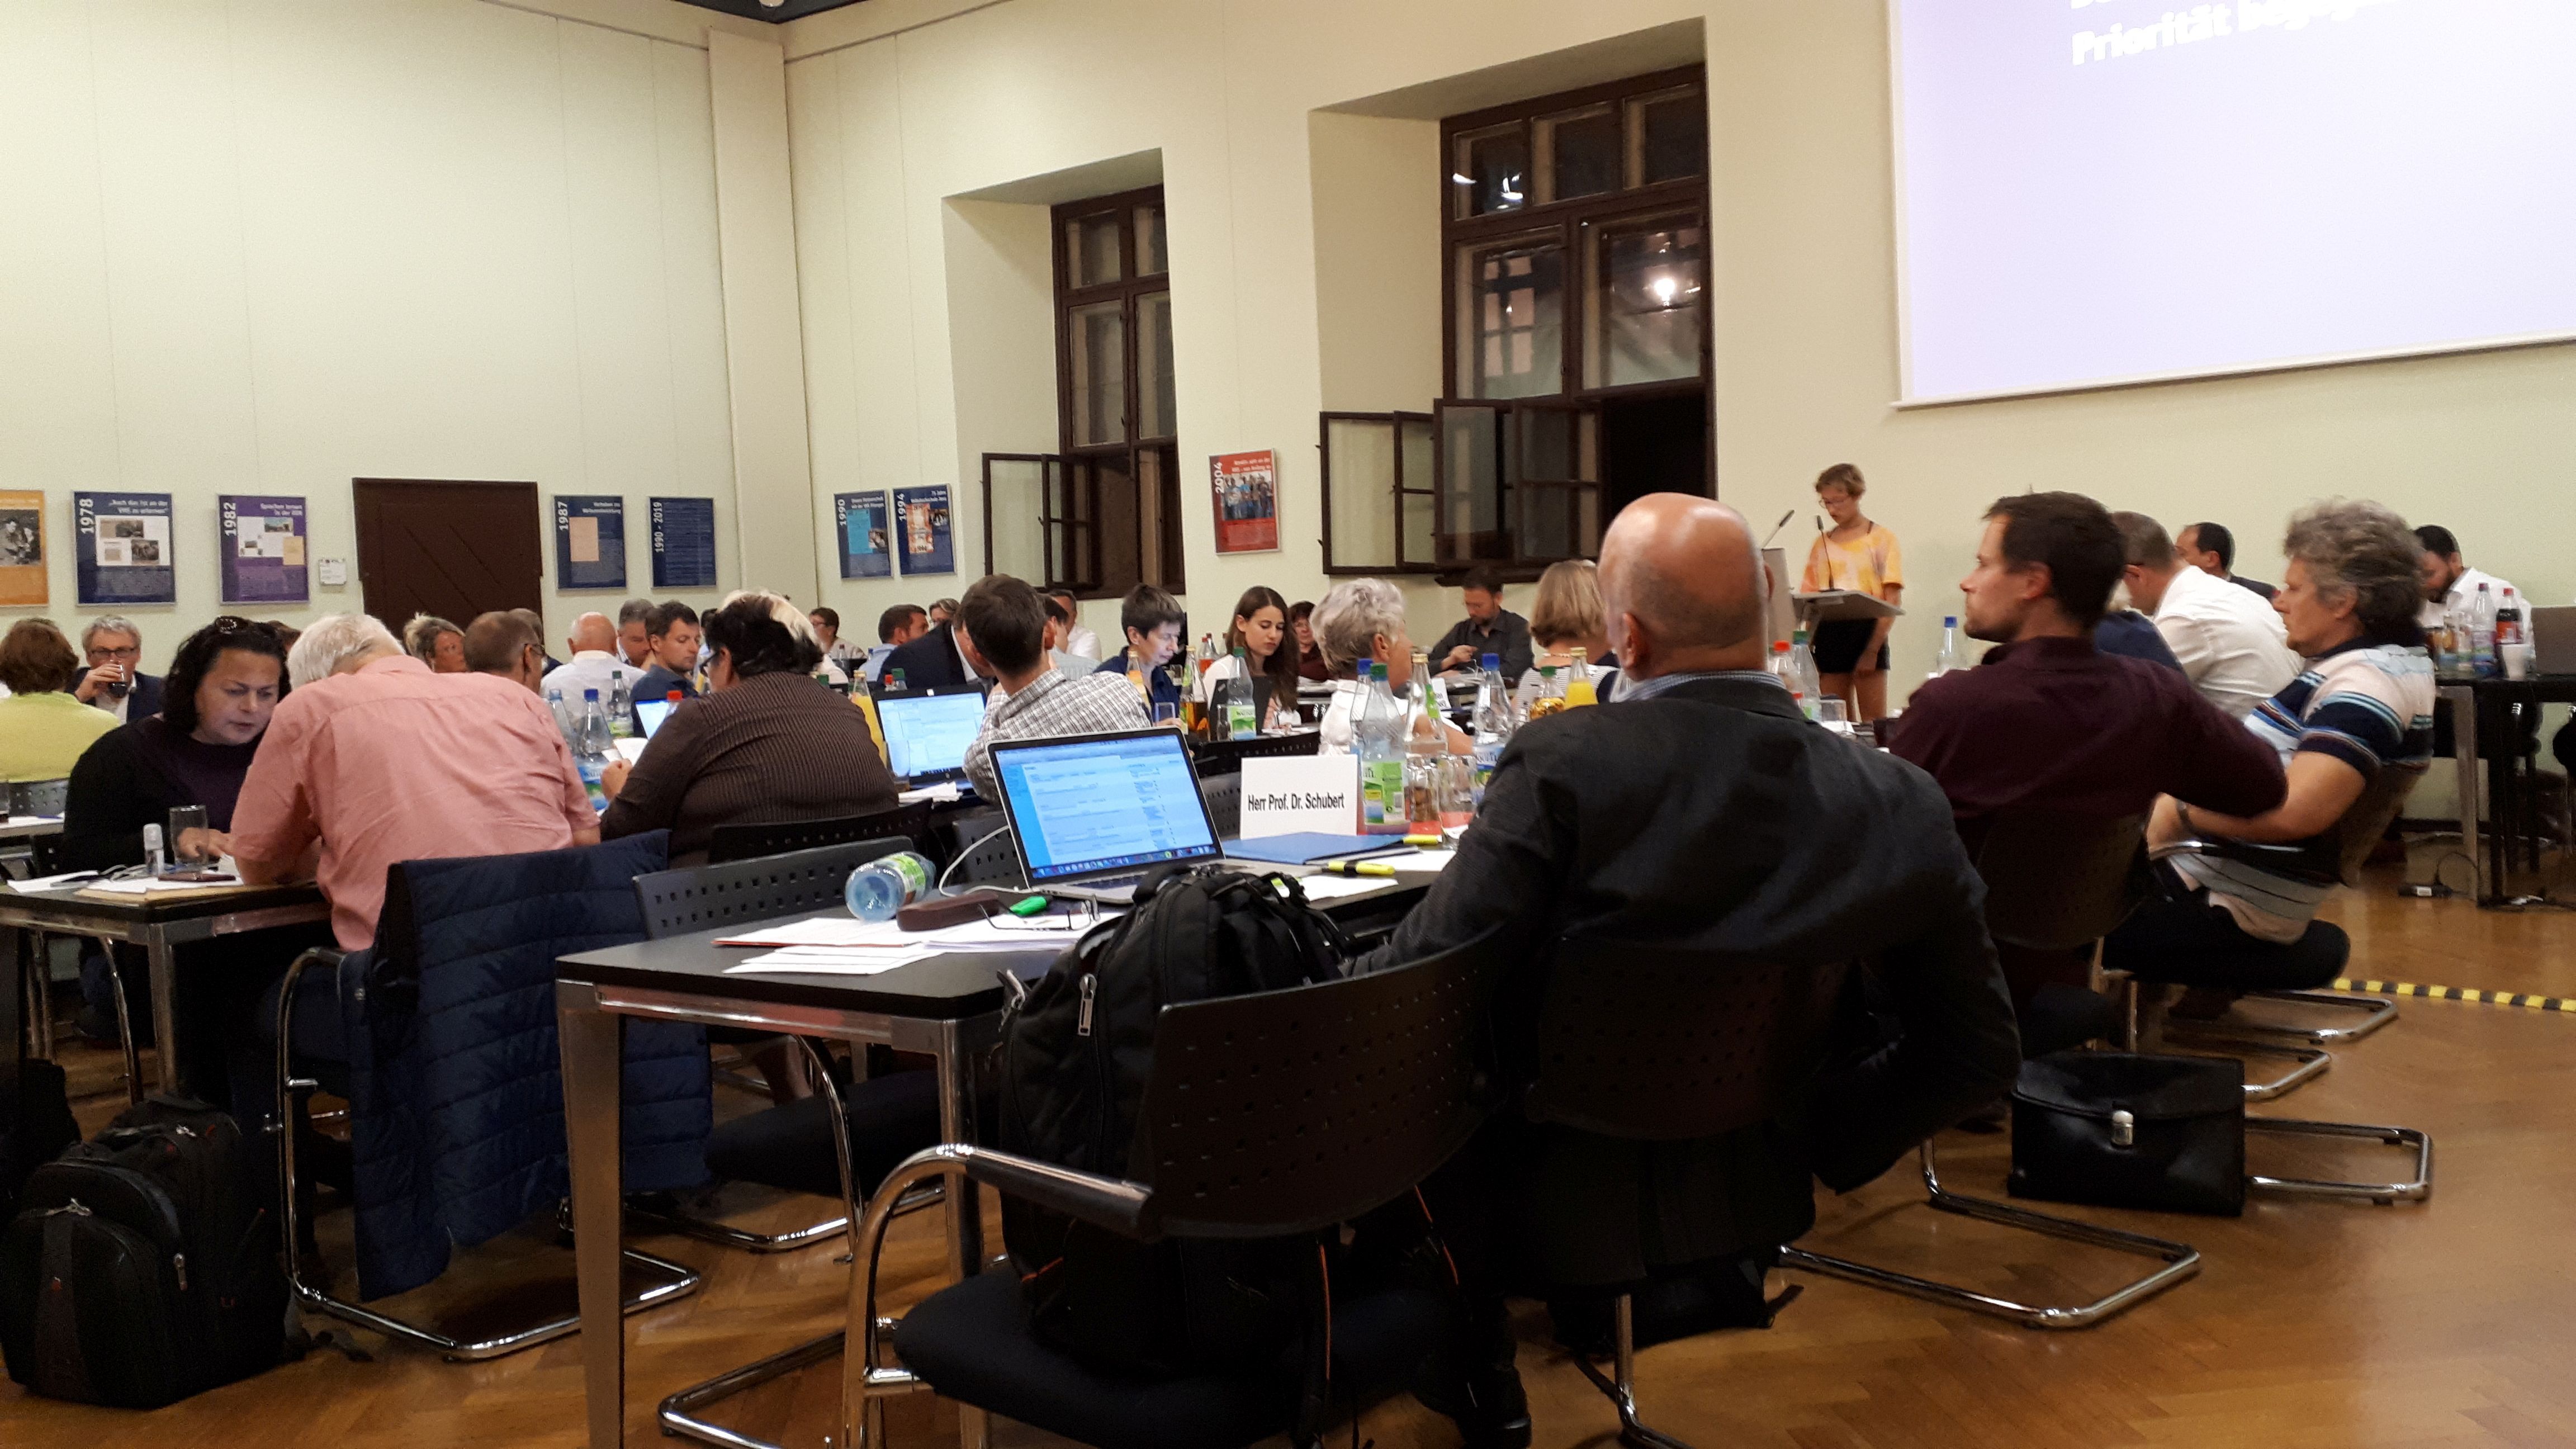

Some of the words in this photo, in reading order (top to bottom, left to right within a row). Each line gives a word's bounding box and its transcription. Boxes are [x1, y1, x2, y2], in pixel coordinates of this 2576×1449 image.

[2072, 3, 2232, 65] Priorität
[1214, 462, 1225, 494] 2004
[79, 498, 95, 534] 1978
[224, 502, 236, 537] 1982
[557, 501, 569, 531] 1987
[652, 501, 664, 523] 2019
[837, 499, 847, 527] 1990
[897, 493, 906, 522] 1994
[654, 531, 664, 553] 1990
[1248, 794, 1266, 811] Herr
[1268, 793, 1289, 811] Prof.
[1291, 792, 1303, 809] Dr.
[1305, 792, 1345, 809] Schubert
